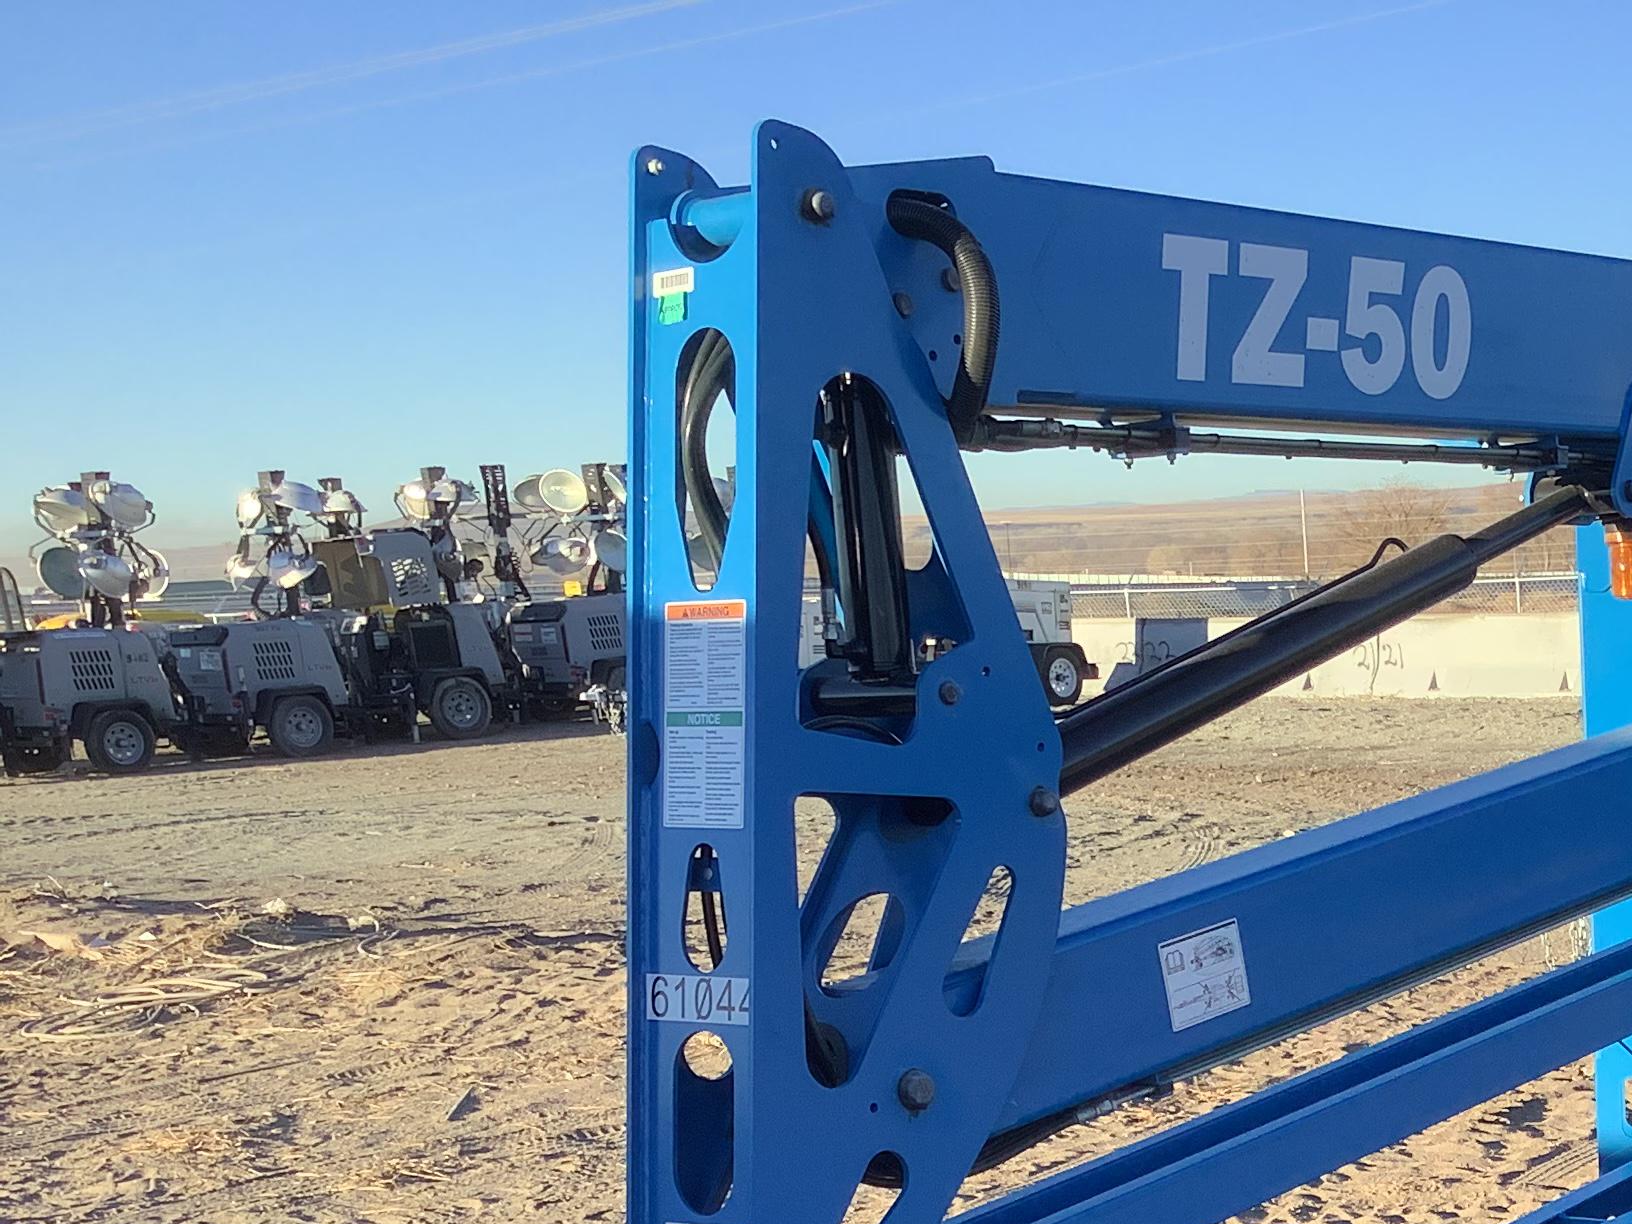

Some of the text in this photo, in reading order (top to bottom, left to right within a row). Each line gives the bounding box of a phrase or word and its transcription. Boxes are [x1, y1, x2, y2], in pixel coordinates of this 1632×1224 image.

[1162, 233, 1471, 400] TZ-50
[689, 606, 730, 618] WARNING
[687, 713, 721, 725] NOTICE
[651, 976, 750, 1021] 61044
